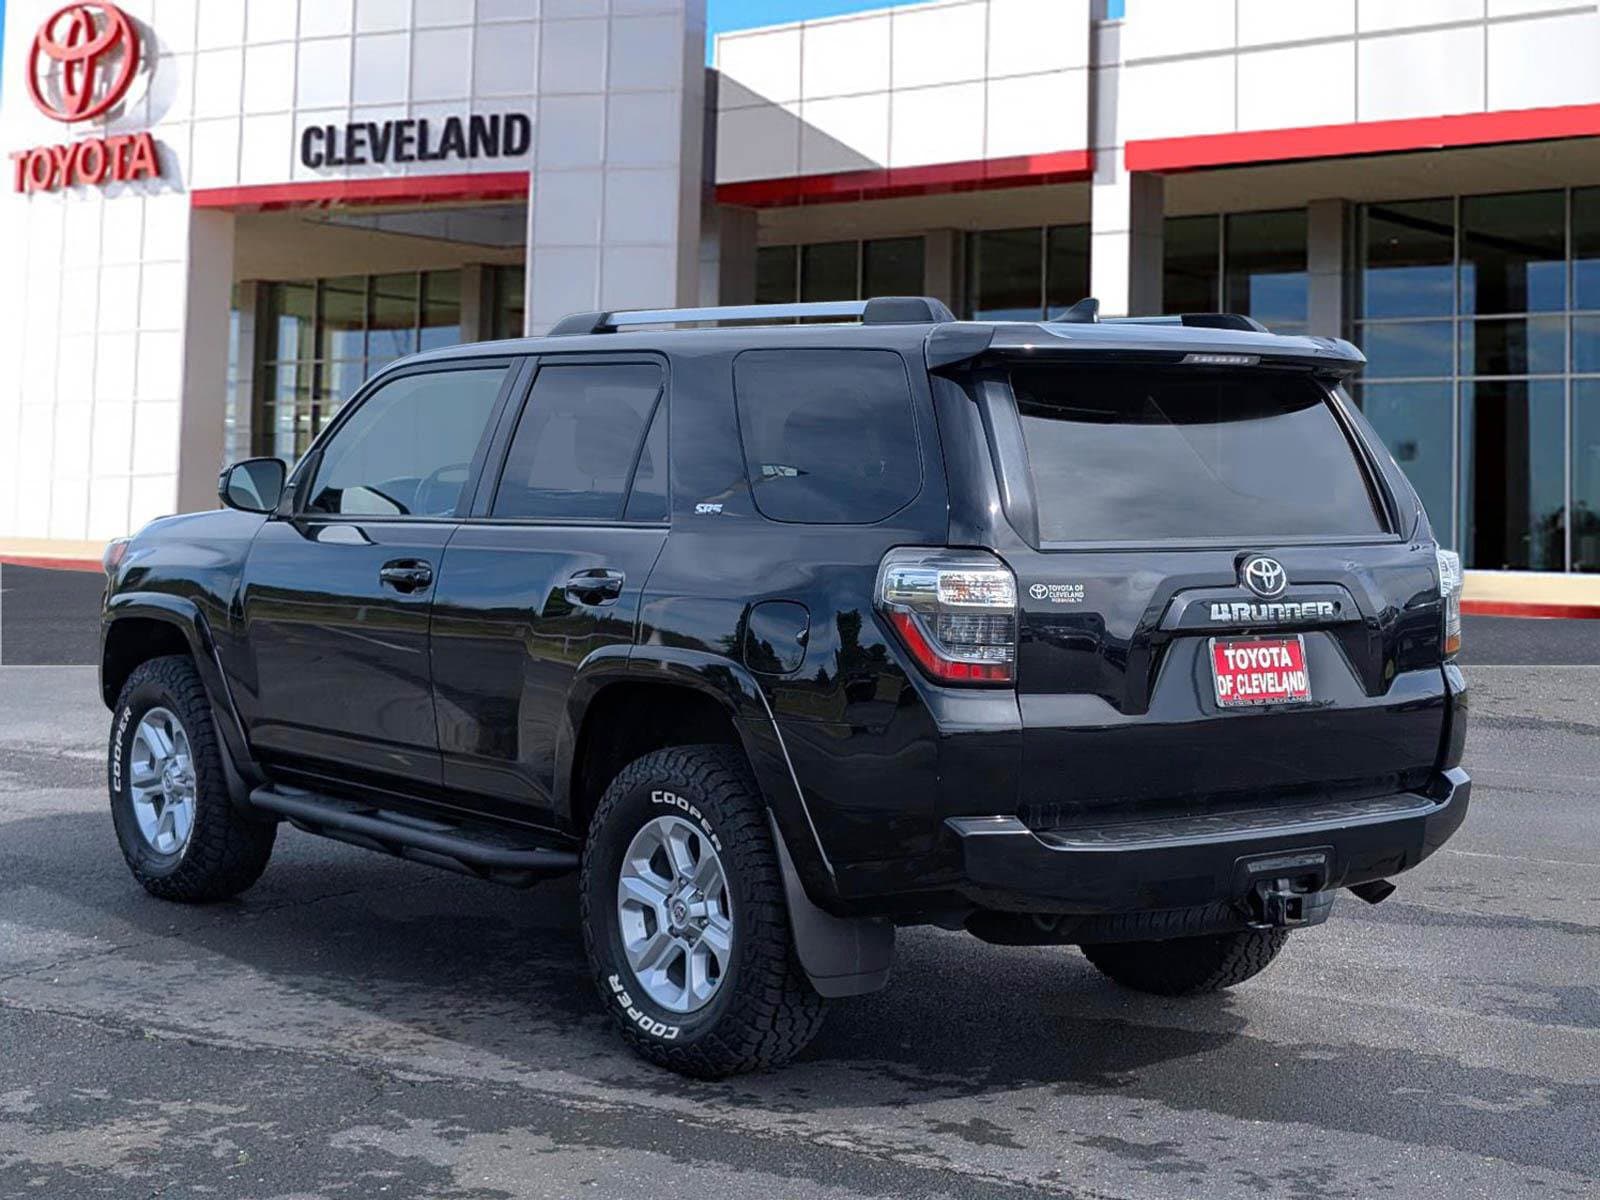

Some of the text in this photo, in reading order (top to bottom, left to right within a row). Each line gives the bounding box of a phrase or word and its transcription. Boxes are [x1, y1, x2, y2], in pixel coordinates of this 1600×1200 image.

[9, 131, 161, 193] TOYOTA
[301, 112, 531, 169] CLEVELAND
[1048, 584, 1084, 592] TOYOTA OF
[1210, 601, 1334, 621] 4RUNNER
[1217, 670, 1307, 696] OF CLEVELAND
[1224, 646, 1293, 670] TOYOTA
[113, 705, 132, 792] COOPER
[651, 790, 722, 852] COOPER
[608, 973, 680, 1039] COOPER
